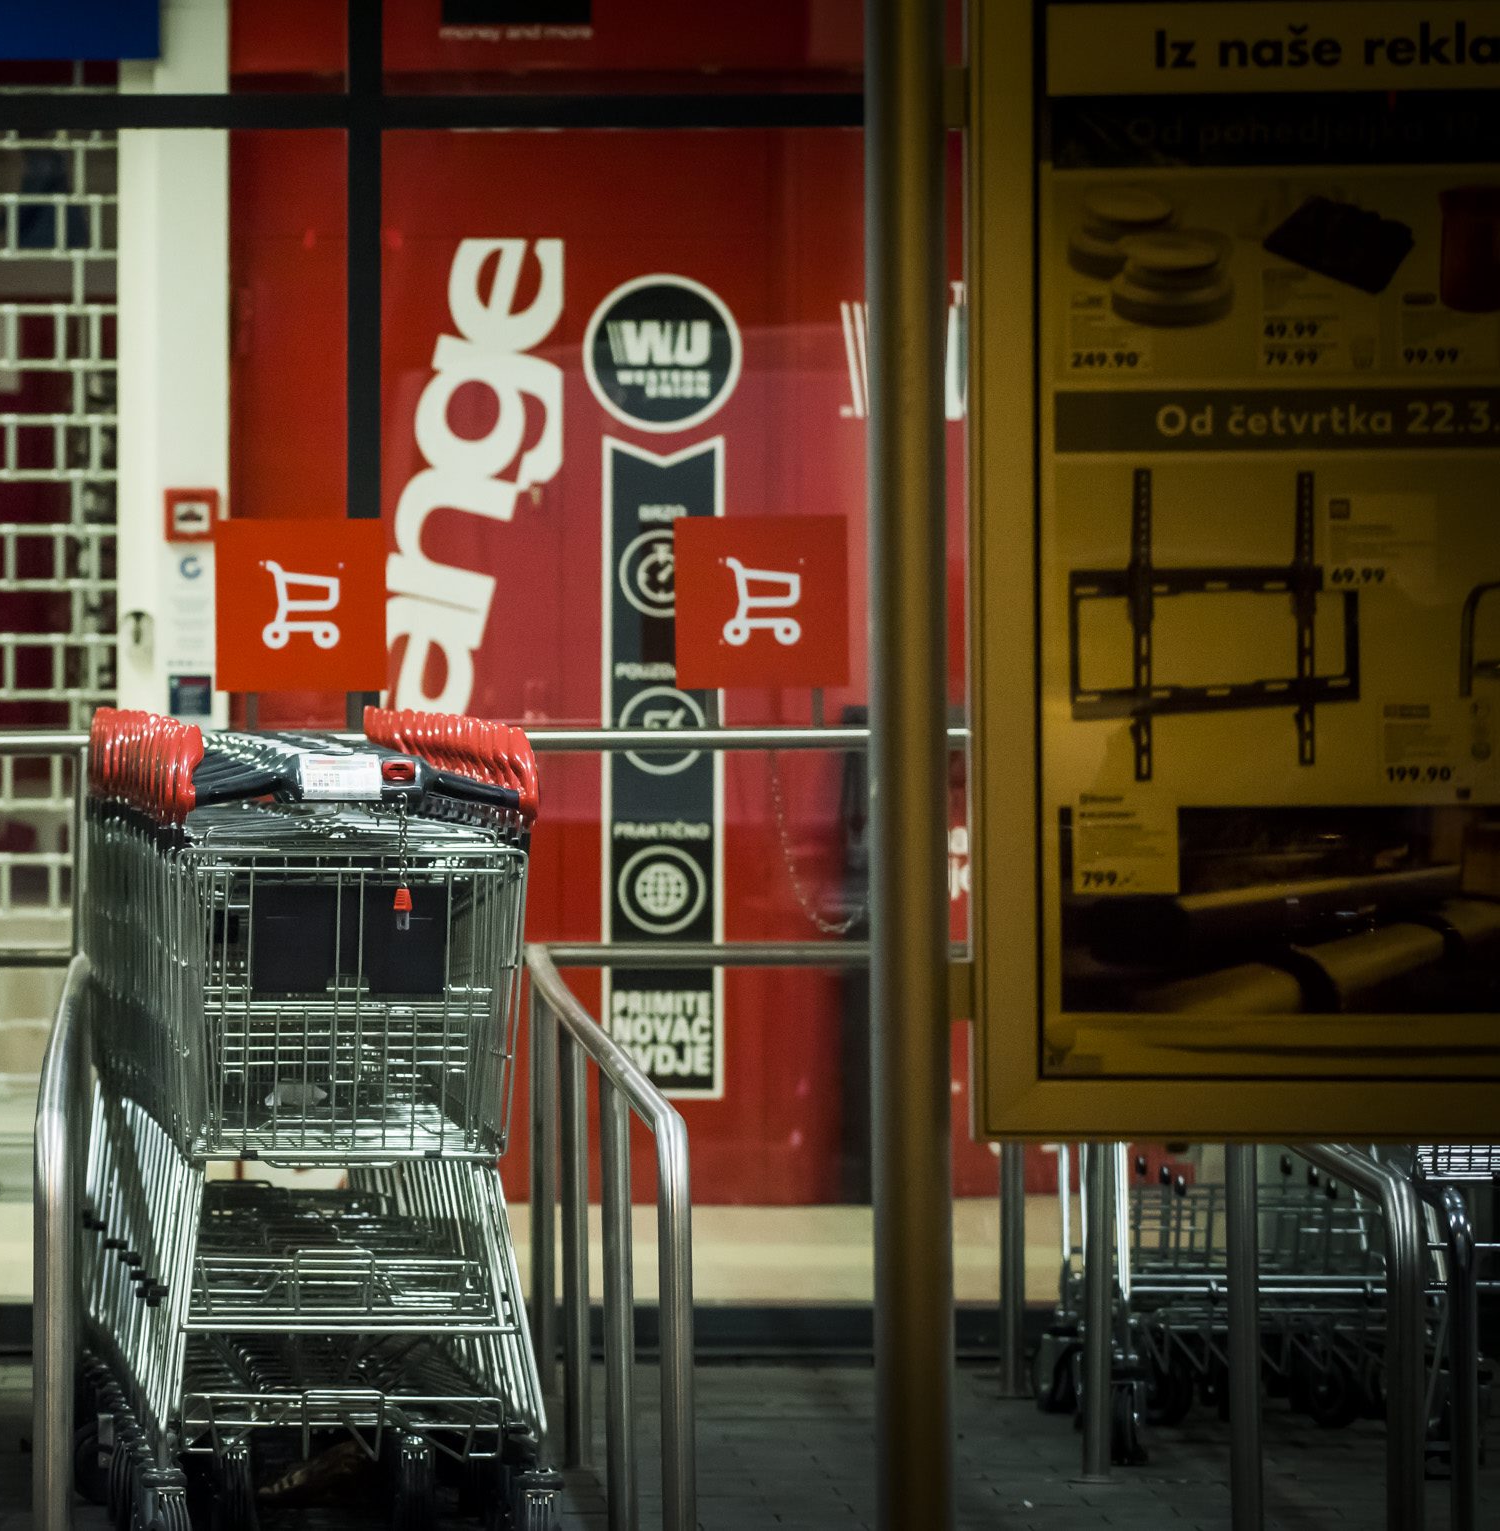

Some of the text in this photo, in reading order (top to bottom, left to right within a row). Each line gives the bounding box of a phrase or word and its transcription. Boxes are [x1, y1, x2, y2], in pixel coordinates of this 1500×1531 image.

[1155, 20, 1500, 68] Iz naše rekla
[605, 319, 712, 368] WU
[1155, 403, 1215, 437] Od
[1226, 402, 1393, 437] četvrtka
[384, 237, 565, 718] ange
[613, 991, 711, 1016] PRIMITE
[613, 1016, 711, 1042] NOVAC
